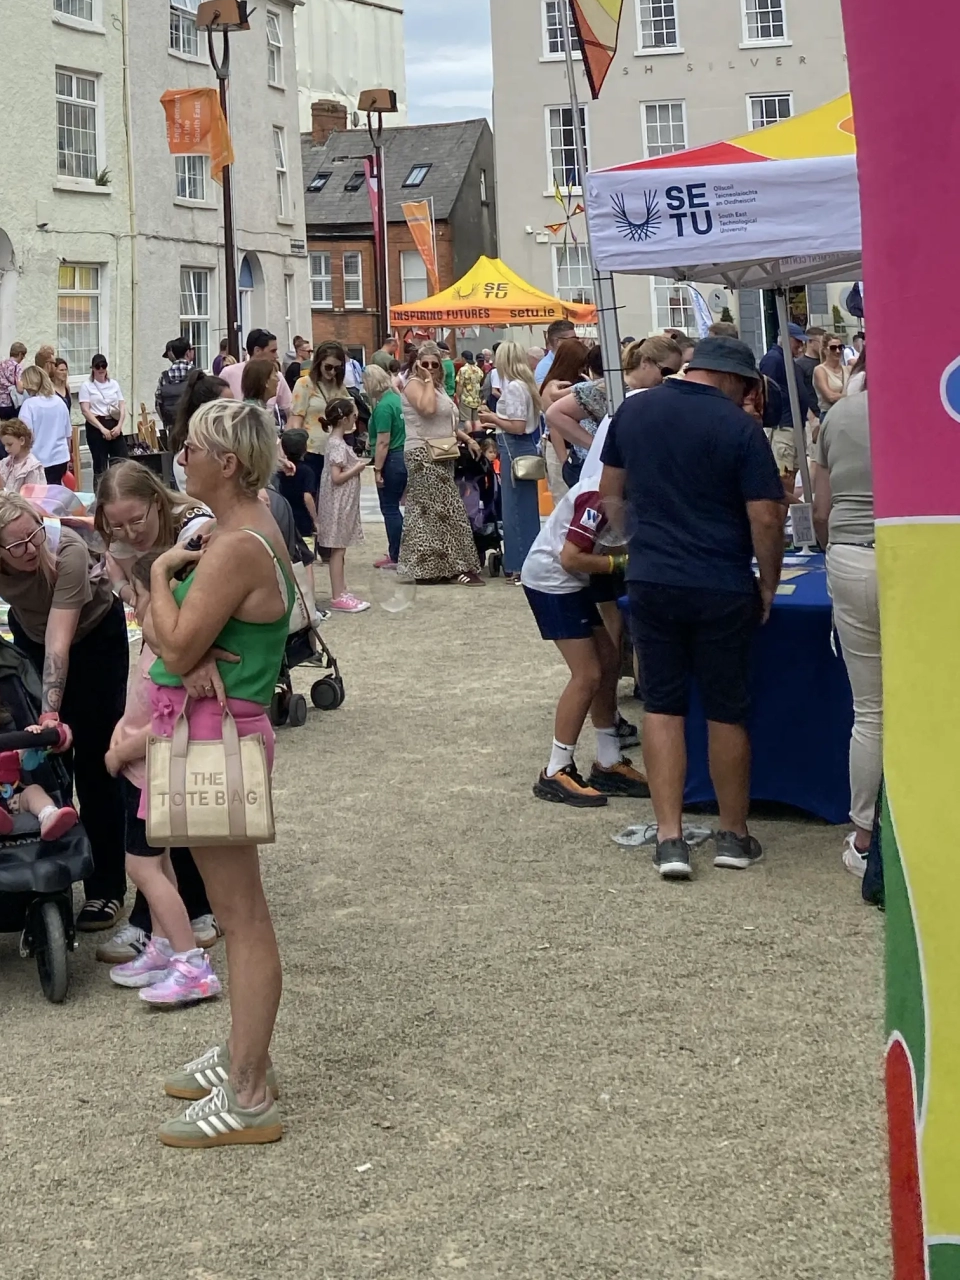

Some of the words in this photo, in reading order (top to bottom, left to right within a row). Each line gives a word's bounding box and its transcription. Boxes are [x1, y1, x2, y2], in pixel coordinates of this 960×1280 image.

[686, 54, 807, 73] SILVER
[193, 100, 201, 118] East
[183, 119, 191, 131] the
[193, 118, 201, 143] South
[184, 131, 191, 143] in
[665, 182, 710, 211] SE
[669, 209, 714, 238] TU
[718, 212, 735, 220] South
[719, 217, 758, 227] Technological
[720, 226, 747, 234] University
[483, 282, 510, 291] SE
[484, 291, 508, 299] TU
[393, 310, 443, 321] INSPIRING
[446, 308, 490, 320] FUTURES
[509, 306, 555, 318] setu.ie
[190, 771, 225, 786] THE
[157, 790, 210, 807] TOTE
[214, 789, 258, 806] BAG
